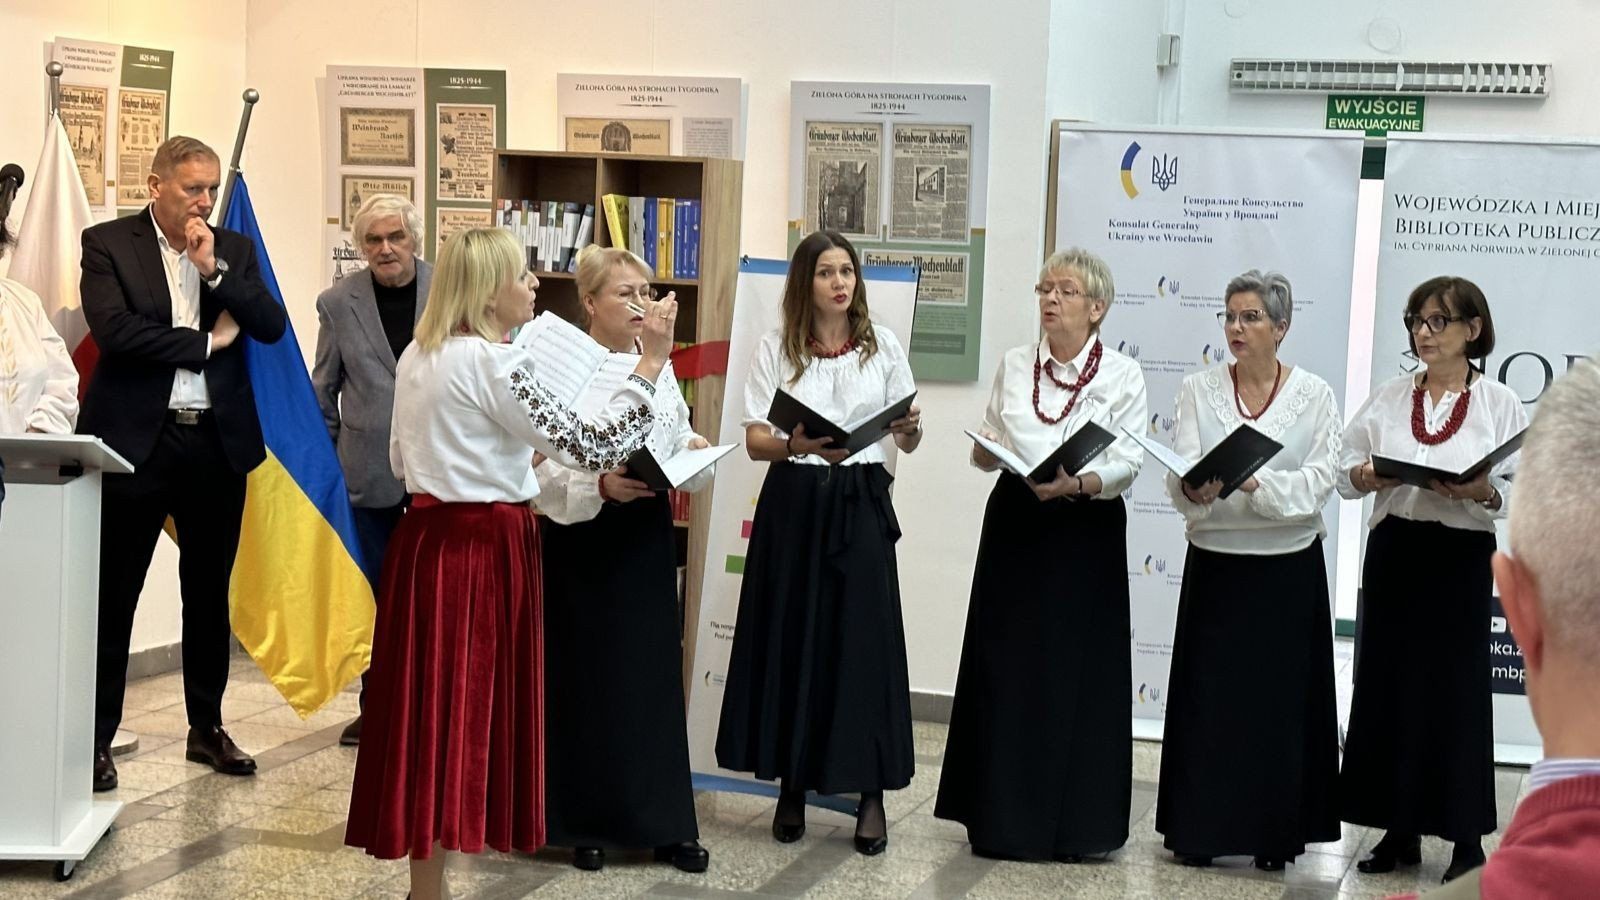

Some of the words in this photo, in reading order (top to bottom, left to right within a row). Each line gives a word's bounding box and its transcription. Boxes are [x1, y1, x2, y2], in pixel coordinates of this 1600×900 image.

[449, 76, 482, 85] 1825-1944
[575, 84, 604, 92] ZIELONA
[606, 83, 626, 92] GÓRA
[678, 86, 719, 94] TYGODNIKA
[811, 90, 843, 98] ZIELONA
[844, 90, 866, 98] GÓRA
[880, 92, 920, 100] STRONACH
[922, 92, 967, 102] TYGODNIKA
[870, 102, 906, 110] 1825-1944
[1334, 96, 1417, 116] WYJŚCIE
[1328, 118, 1421, 131] EWAKUACYJNE
[1183, 195, 1239, 208] Генеральне
[1242, 197, 1304, 209] Консульство
[1394, 193, 1537, 215] WOJEWÓDZKA
[1544, 200, 1549, 214] I
[1556, 200, 1600, 219] MIEJ
[1183, 208, 1222, 220] України
[1234, 210, 1279, 221] Вроцлаві
[1108, 219, 1150, 229] Konsulat
[1152, 220, 1200, 232] Generalny
[1396, 218, 1510, 238] BIBLIOTEKA
[1108, 232, 1145, 243] Ukrainy
[1164, 233, 1213, 244] Wrocławiu
[1394, 242, 1409, 250] IM.
[1411, 241, 1468, 254] CYPRIANA
[1470, 243, 1525, 255] NORWIDA
[1528, 246, 1538, 255] W
[1540, 246, 1591, 258] ZIELONEJ
[913, 255, 964, 274] Wochenblatt
